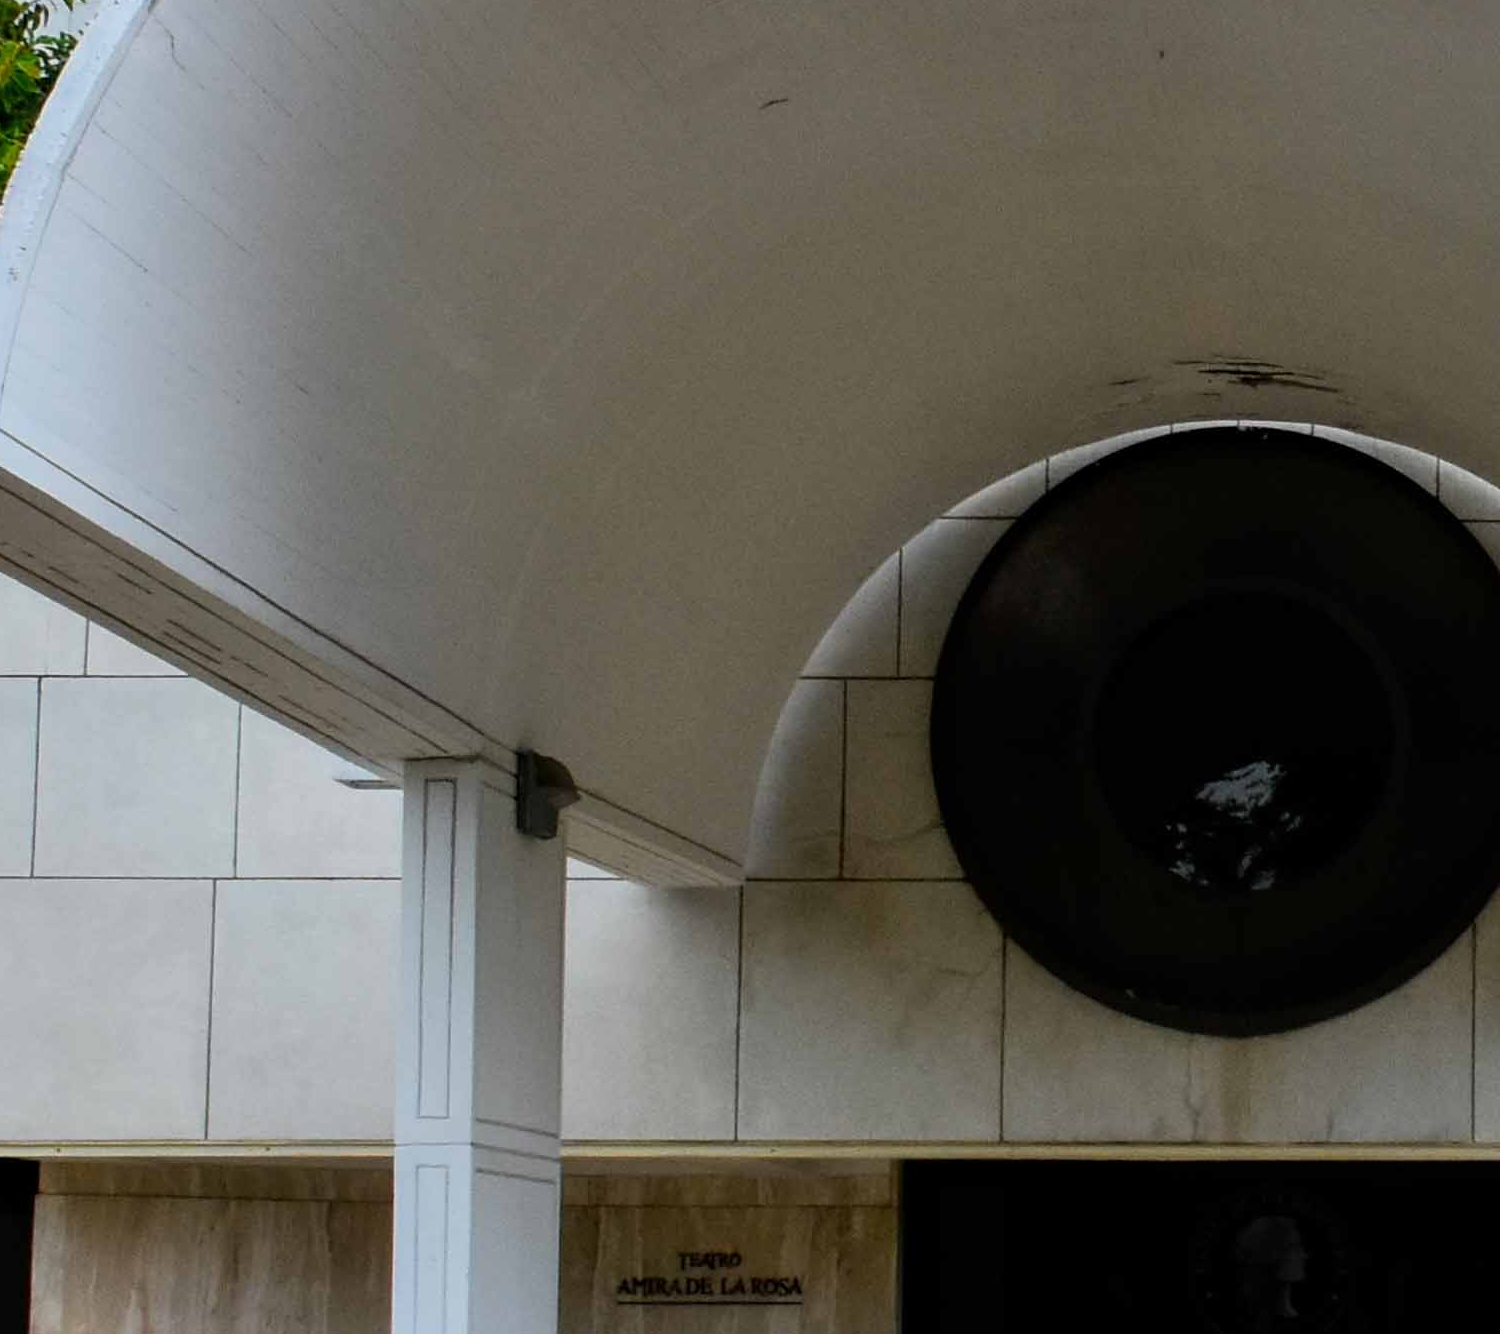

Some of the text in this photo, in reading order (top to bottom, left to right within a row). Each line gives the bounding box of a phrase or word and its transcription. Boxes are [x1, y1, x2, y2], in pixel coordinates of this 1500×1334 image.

[678, 1252, 742, 1270] TEATRO
[618, 1277, 802, 1297] AMIRA DE LA ROSA
